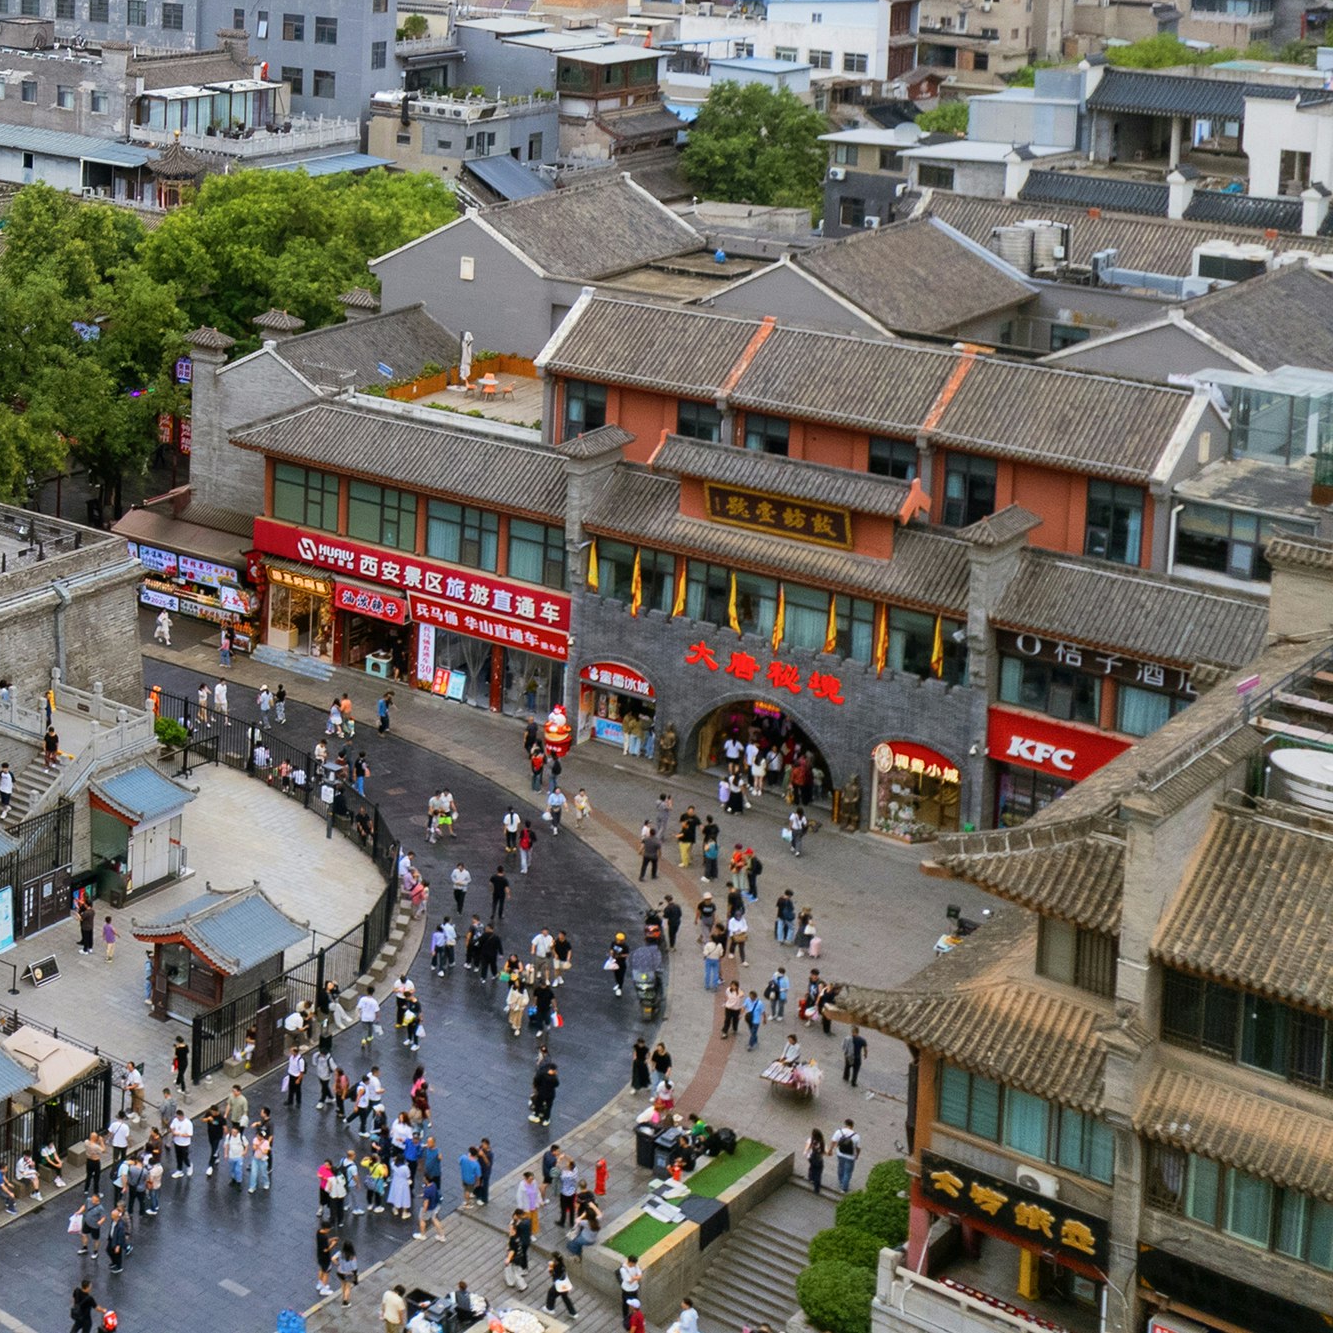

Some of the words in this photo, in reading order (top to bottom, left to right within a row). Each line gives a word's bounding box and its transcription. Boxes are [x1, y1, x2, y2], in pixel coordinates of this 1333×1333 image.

[342, 590, 398, 617] 油泼辣子
[360, 554, 561, 624] 西安景区旅游直通车
[416, 602, 459, 627] 兵马俑
[464, 616, 540, 647] 华山直通车
[685, 640, 846, 706] 大唐秘境
[1007, 735, 1076, 771] KFC
